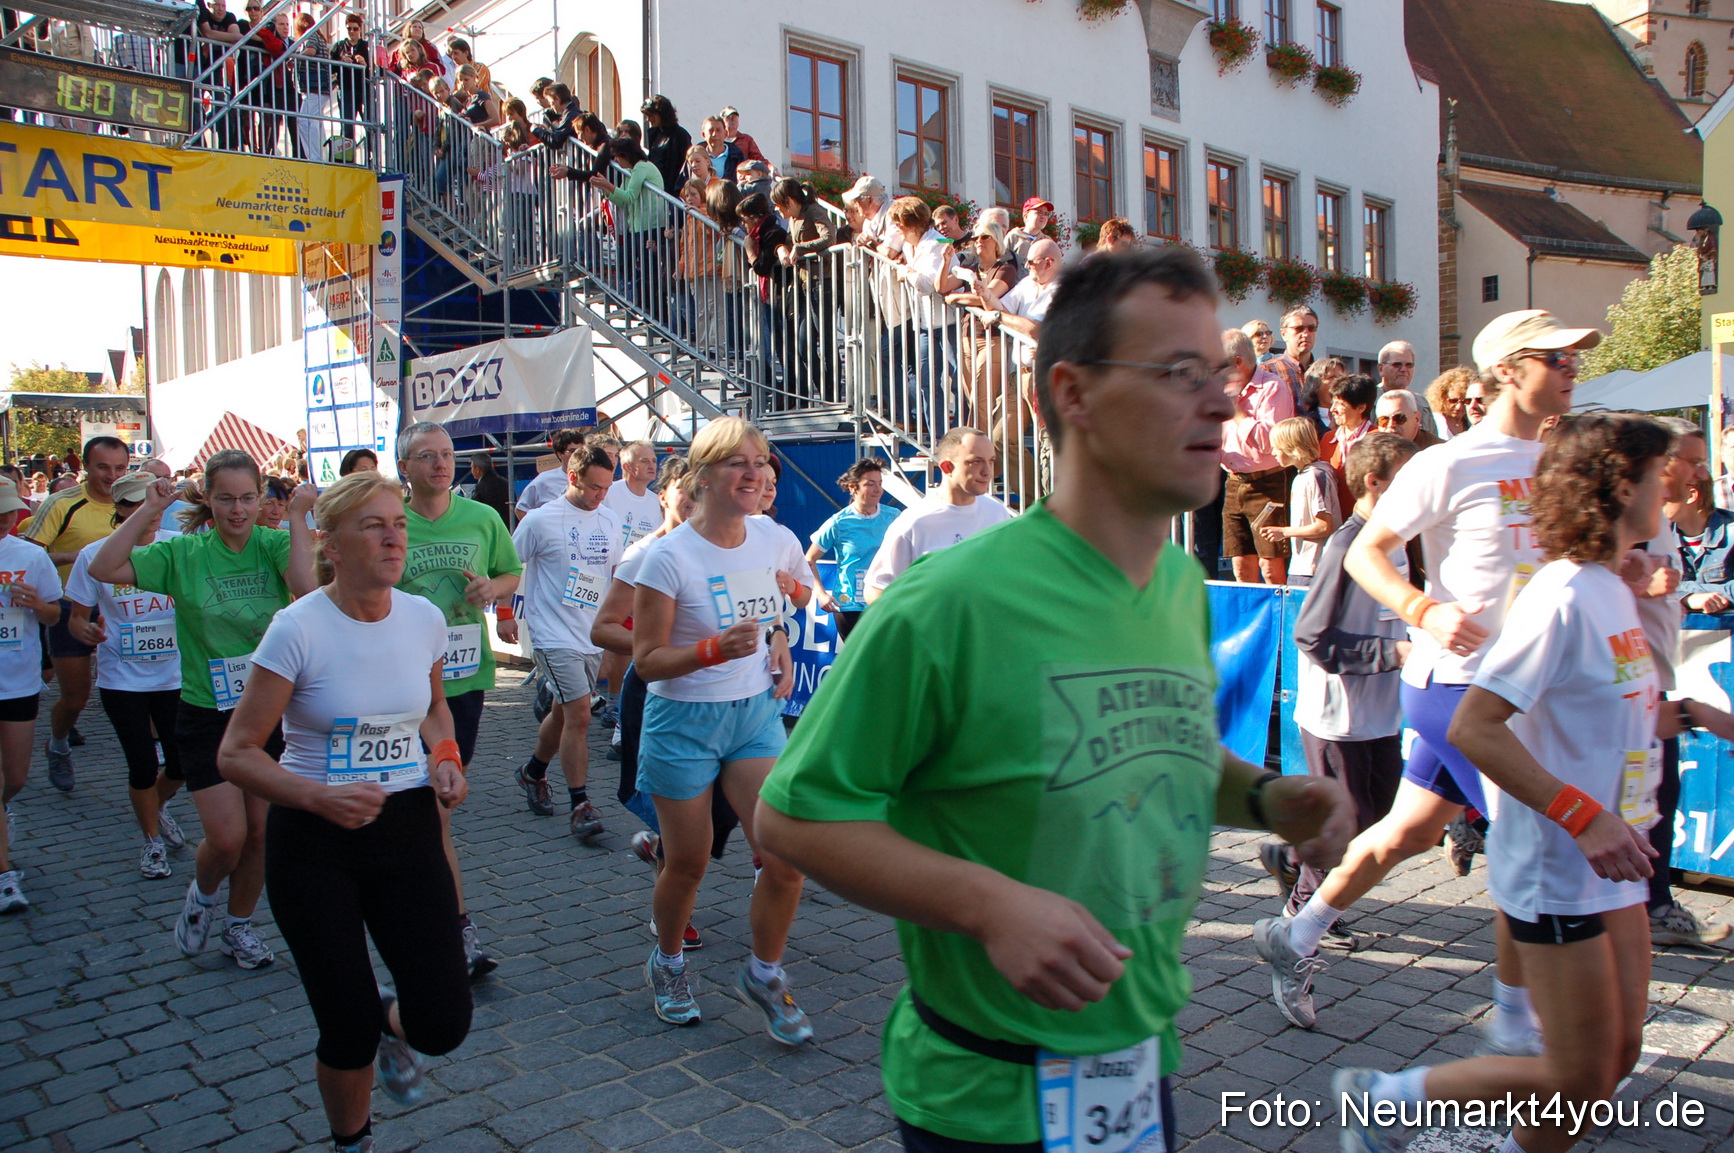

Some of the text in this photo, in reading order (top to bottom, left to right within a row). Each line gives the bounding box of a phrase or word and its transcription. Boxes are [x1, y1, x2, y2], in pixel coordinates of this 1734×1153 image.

[215, 197, 346, 219] Neumarkter Stadtlauf
[1715, 318, 1734, 328] Sta
[413, 357, 504, 411] BOCK
[413, 544, 469, 561] ATEMLOS
[410, 556, 470, 577] DETTINGEN
[218, 574, 266, 589] ATEMLOS
[574, 586, 599, 603] 2769
[737, 595, 777, 618] 3731
[135, 625, 157, 634] Petra
[138, 637, 174, 651] 2684
[228, 662, 247, 673] Lisa
[360, 723, 391, 736] Rosa
[359, 736, 412, 762] 2057
